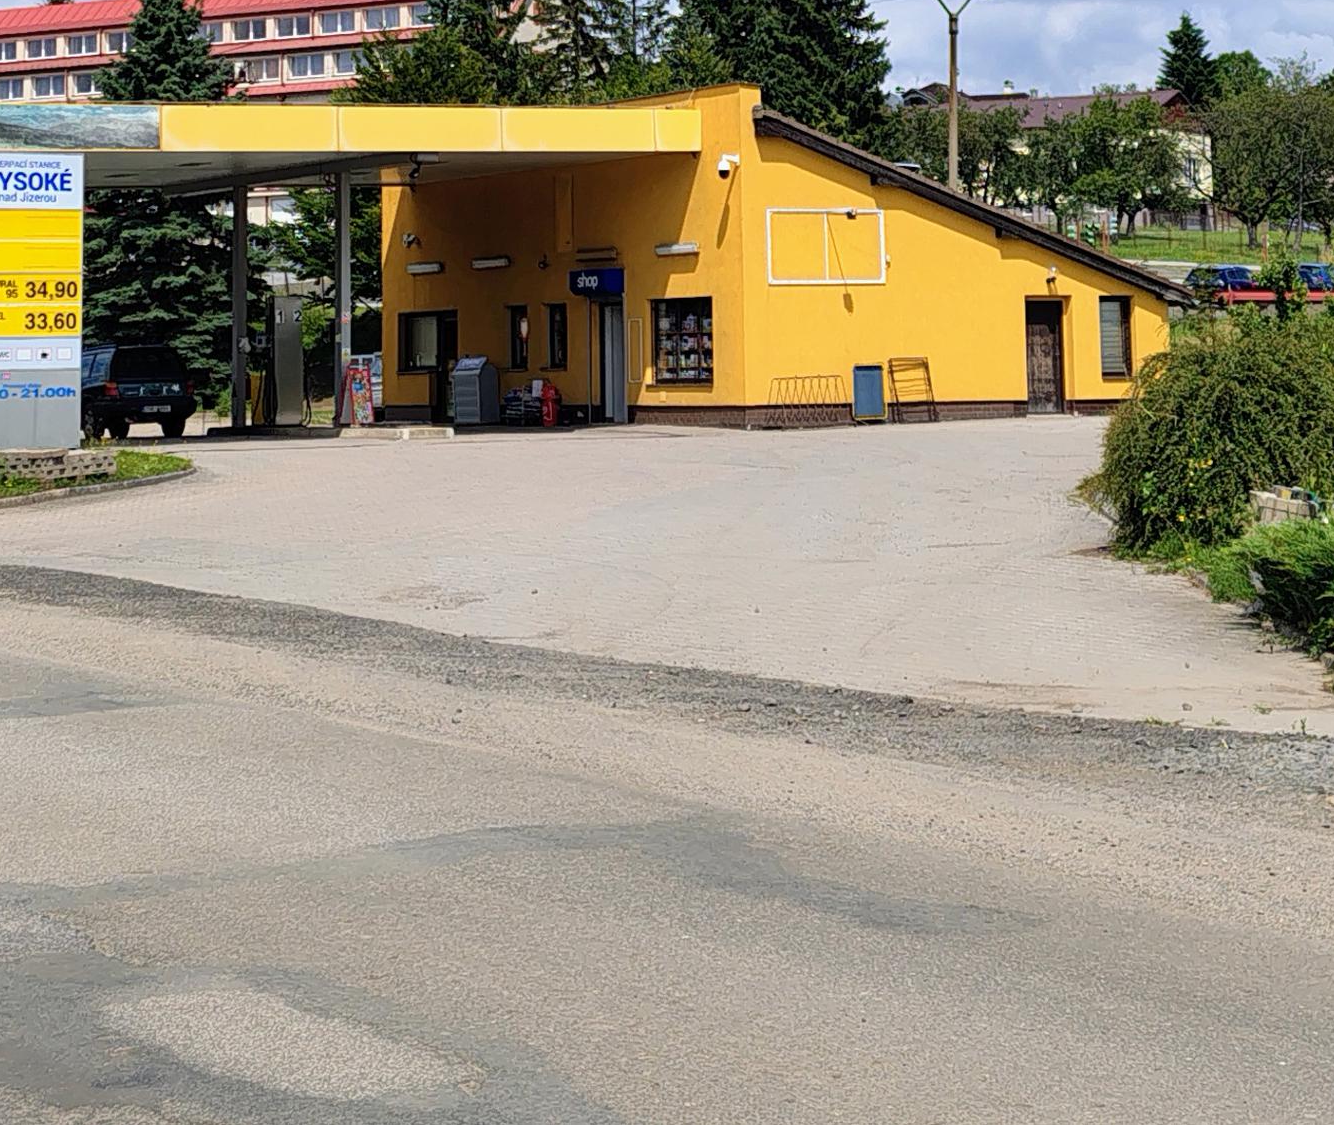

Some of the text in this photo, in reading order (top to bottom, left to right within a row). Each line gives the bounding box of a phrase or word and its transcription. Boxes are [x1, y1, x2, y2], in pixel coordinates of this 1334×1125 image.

[29, 161, 62, 169] STANICE
[20, 192, 58, 203] Jizerou
[577, 272, 599, 290] shop
[5, 289, 18, 299] 95
[25, 281, 78, 301] 34,90
[24, 312, 77, 332] 33,60
[277, 310, 302, 322] 1 2
[21, 386, 76, 398] 21.00h
